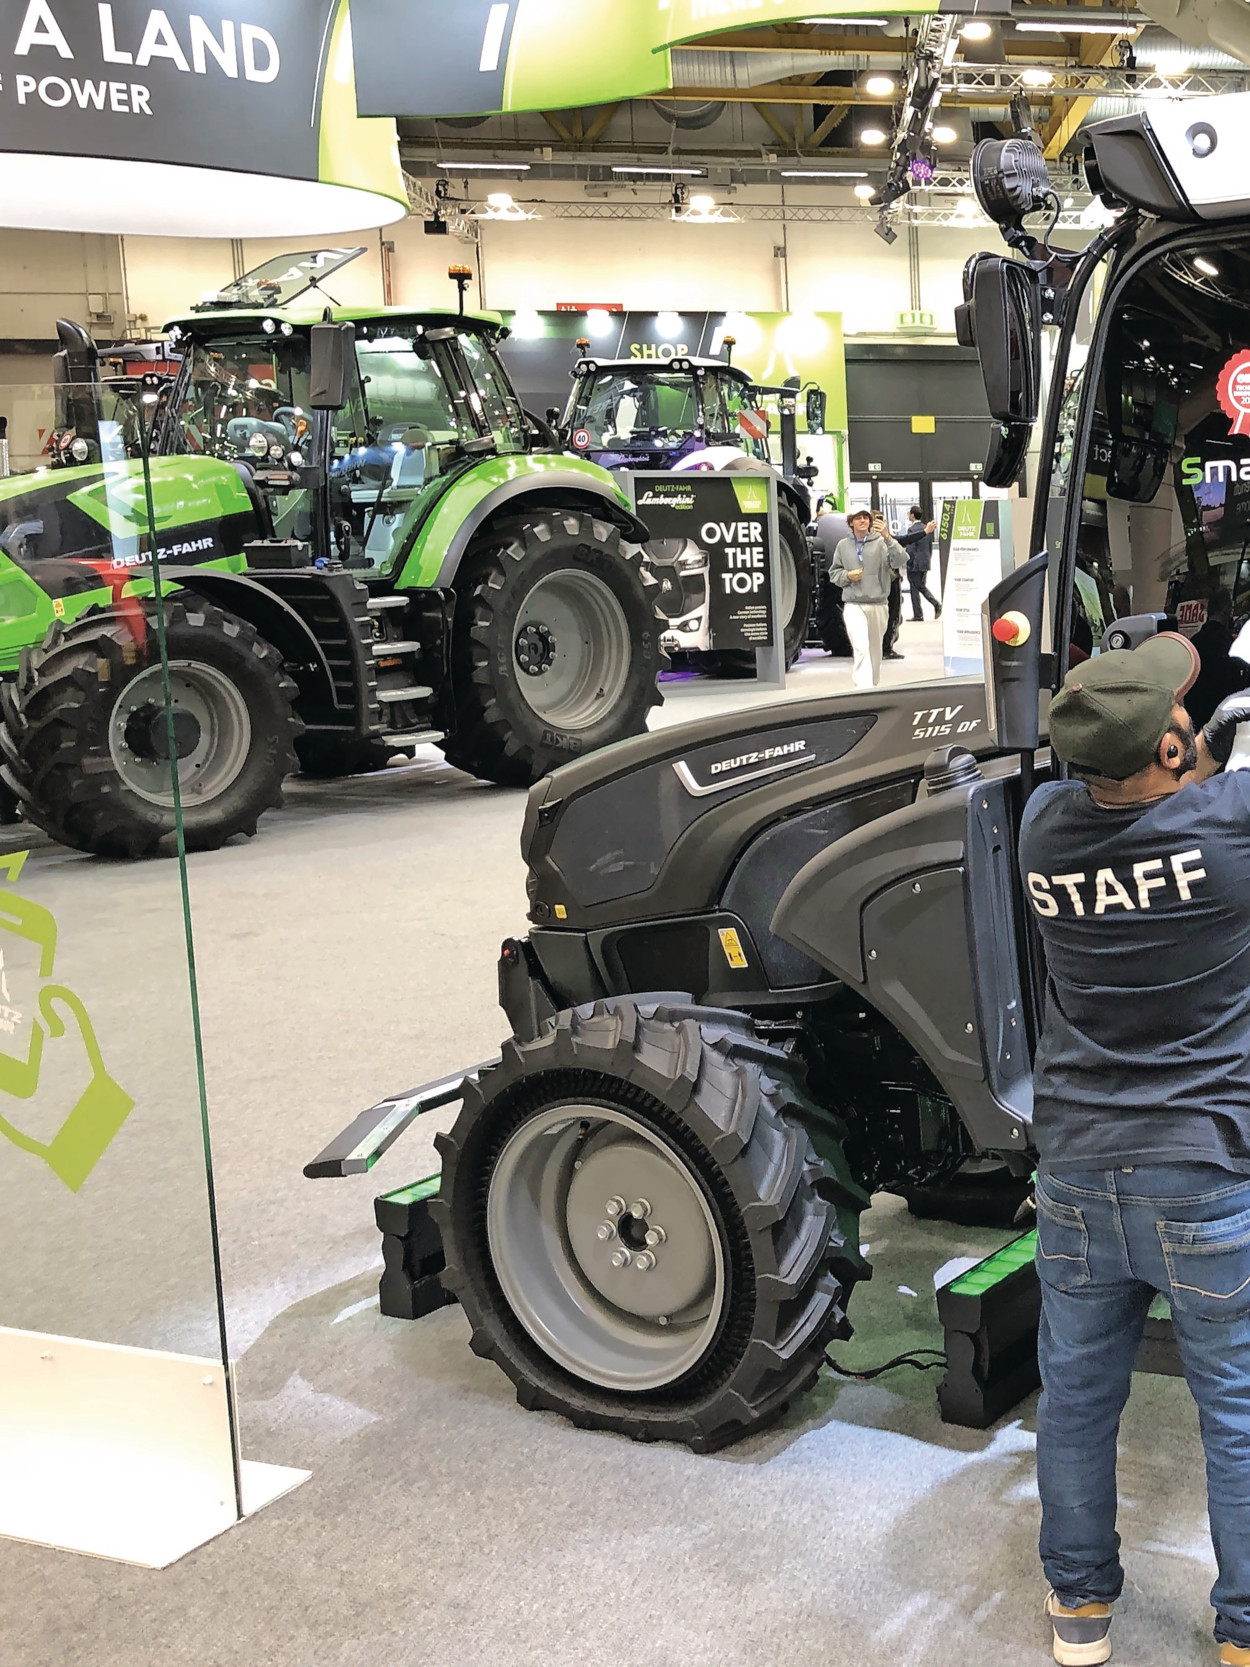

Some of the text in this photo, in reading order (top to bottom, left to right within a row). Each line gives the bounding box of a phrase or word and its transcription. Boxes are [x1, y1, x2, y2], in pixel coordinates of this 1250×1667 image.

[14, 0, 281, 84] A LAND
[16, 74, 154, 116] POWER
[629, 343, 689, 360] SHOP
[576, 433, 587, 444] 40
[654, 484, 693, 493] DEUTZ-FAHR
[674, 503, 694, 511] edition
[700, 521, 764, 545] OVER
[939, 502, 952, 541] 6150.4
[723, 546, 765, 570] THE
[721, 571, 766, 595] TOP
[912, 704, 964, 727] TTV
[911, 723, 953, 740] 5115
[710, 739, 807, 775] DEUTZ-FAHR
[1027, 849, 1207, 917] STAFF
